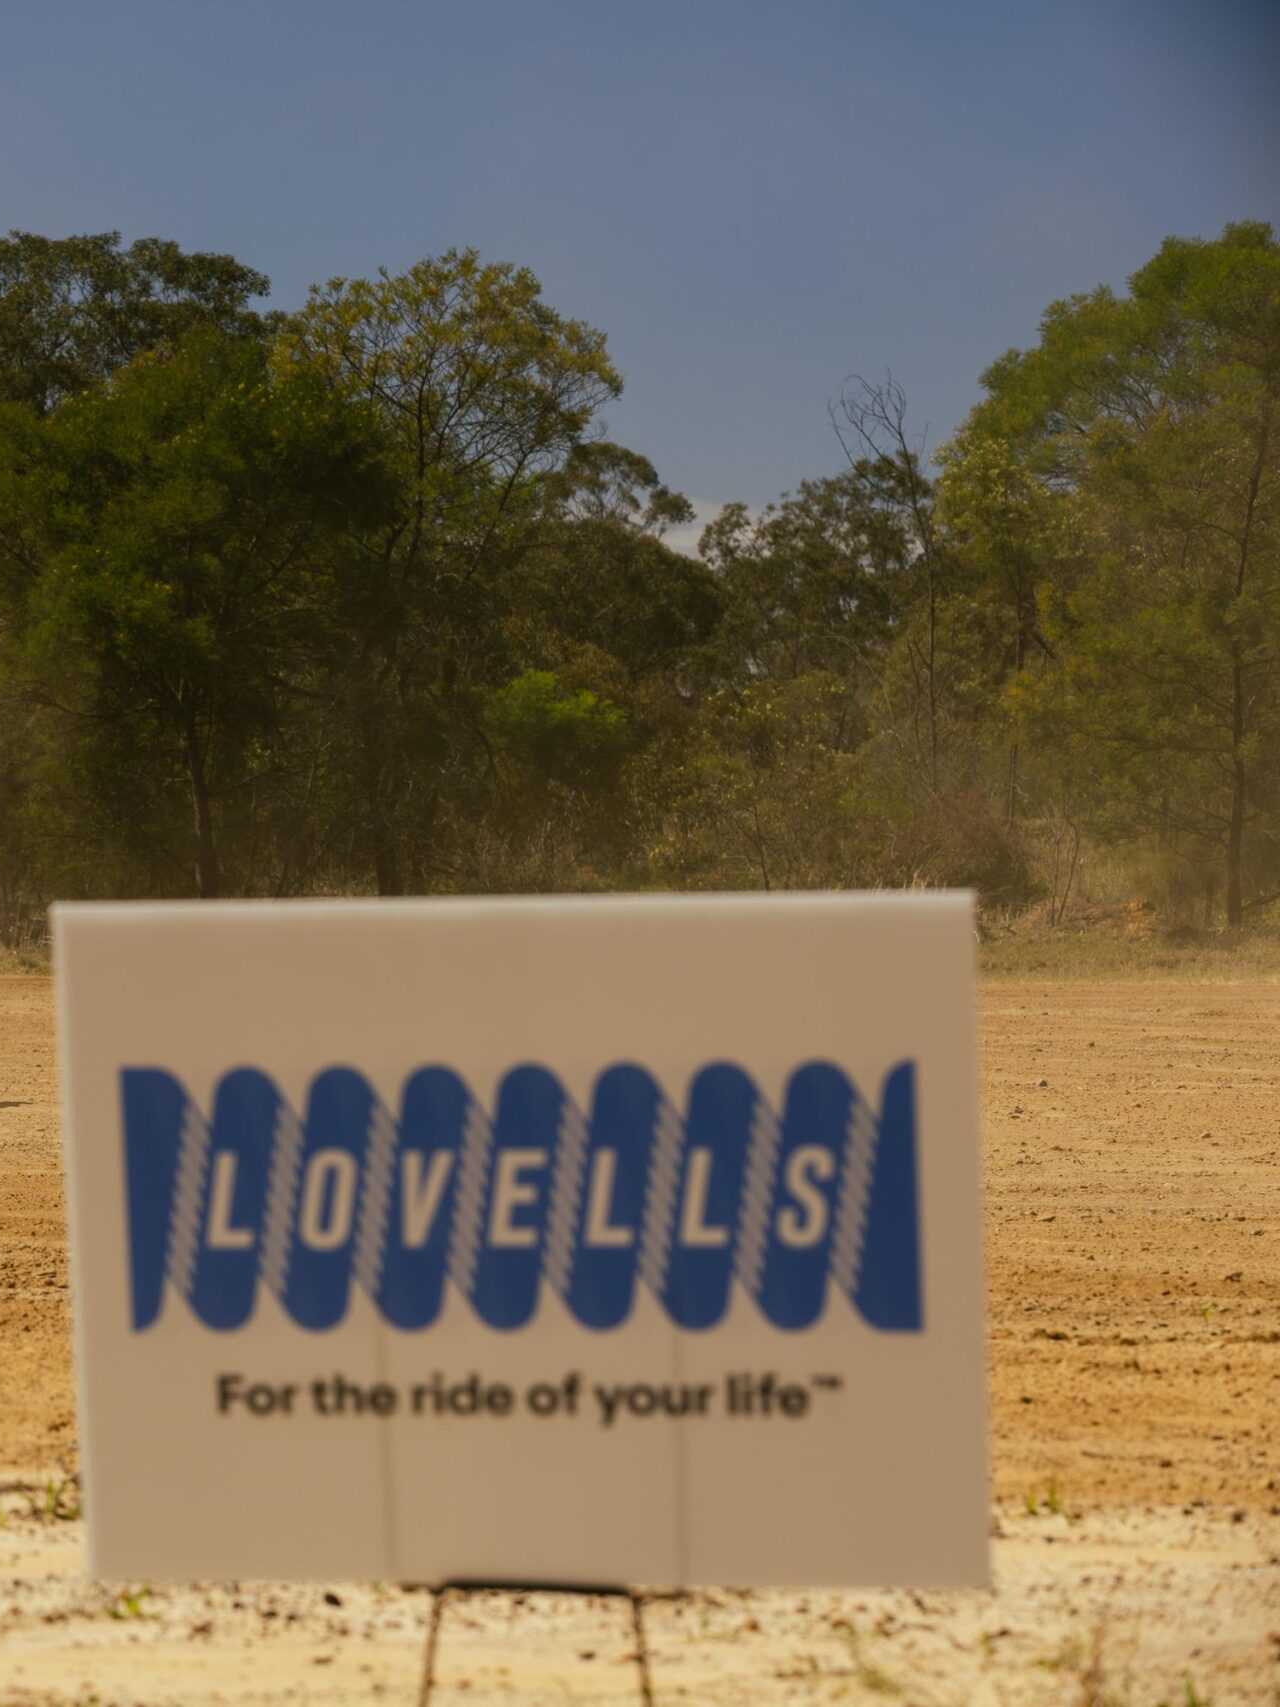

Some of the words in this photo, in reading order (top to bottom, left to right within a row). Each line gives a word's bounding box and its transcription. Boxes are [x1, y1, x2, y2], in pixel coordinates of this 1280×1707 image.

[206, 1145, 834, 1251] LOVELLS
[216, 1372, 296, 1417] For
[312, 1371, 397, 1417] the
[411, 1369, 515, 1417] ride
[526, 1370, 579, 1417] of
[593, 1382, 713, 1429] your
